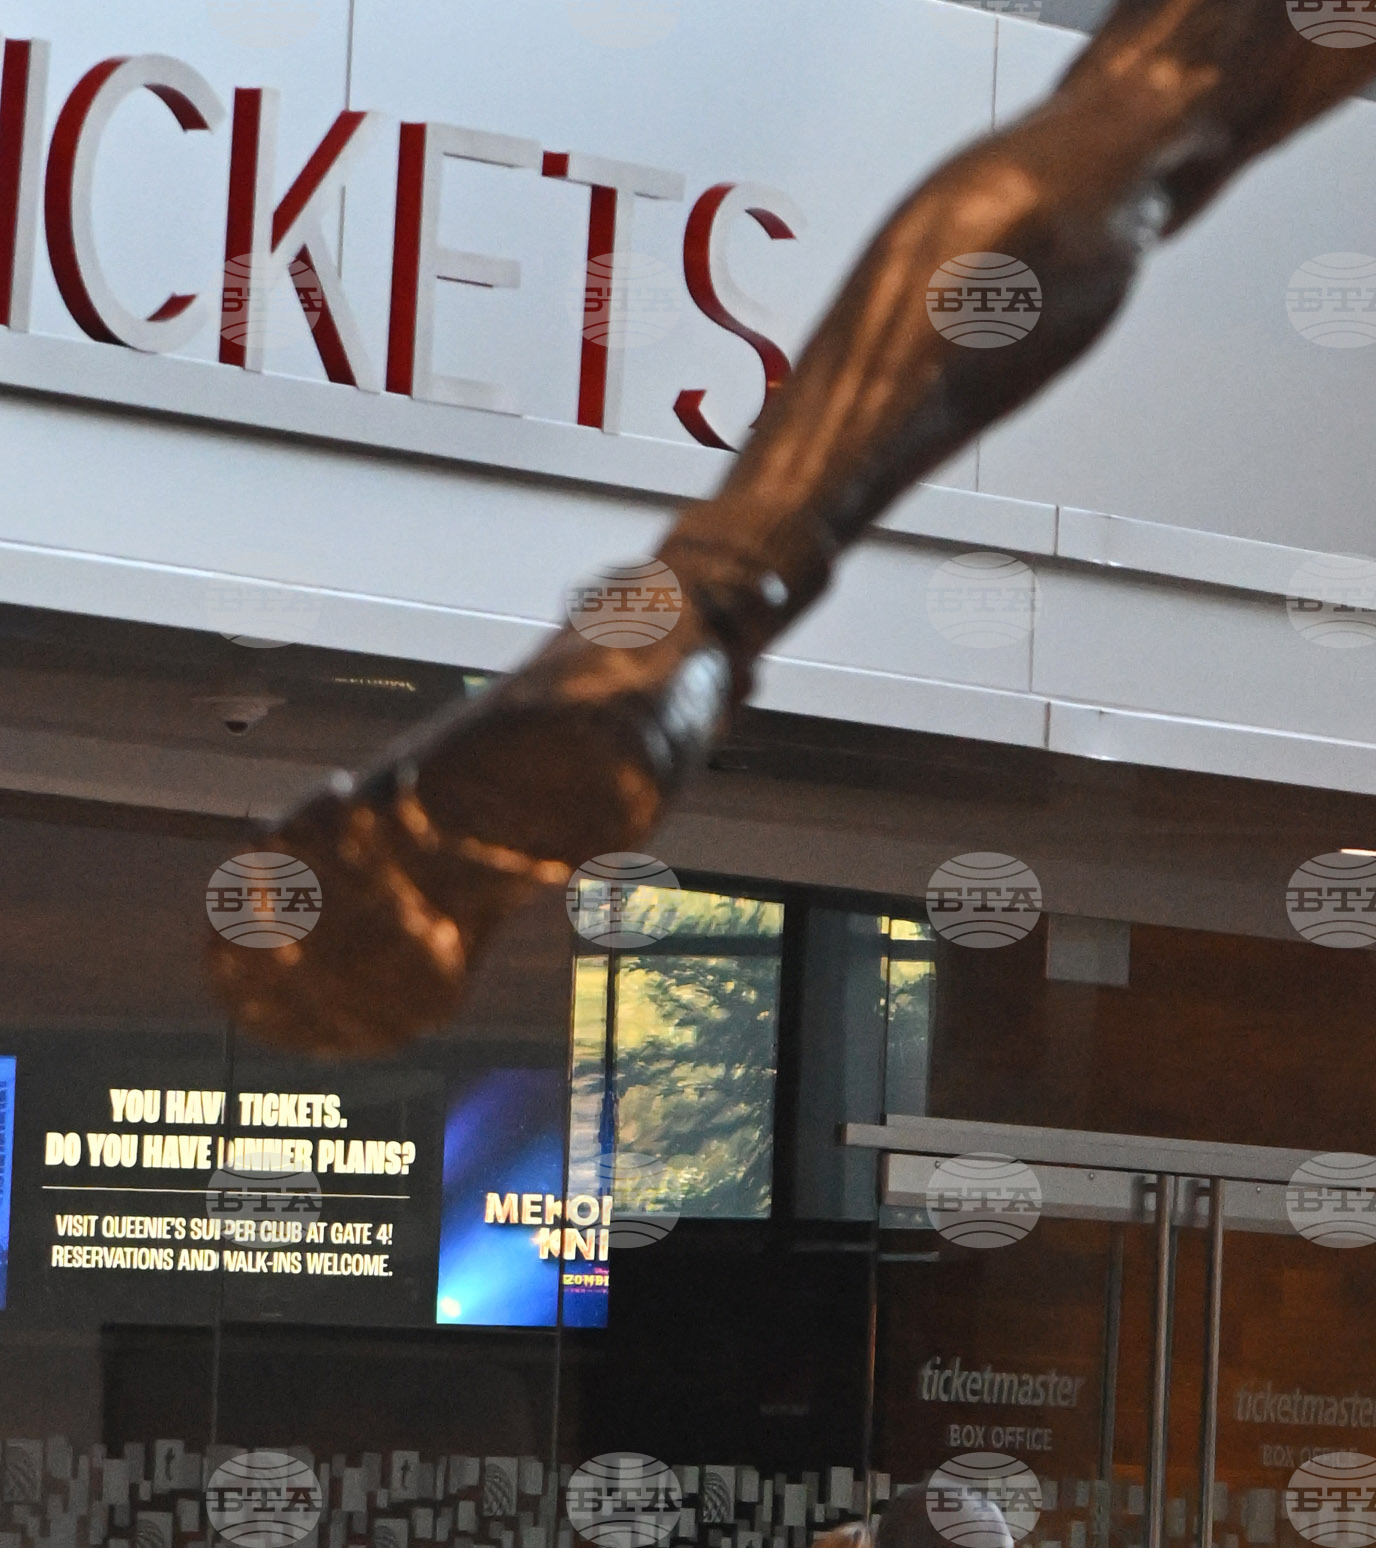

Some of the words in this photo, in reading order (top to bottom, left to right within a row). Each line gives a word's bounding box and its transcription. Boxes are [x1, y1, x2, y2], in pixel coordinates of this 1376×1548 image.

[110, 1089, 161, 1123] YOU
[165, 1090, 228, 1125] HAV
[239, 1092, 348, 1128] TICKETS.
[45, 1132, 82, 1166] DO
[86, 1133, 138, 1167] YOU
[142, 1134, 212, 1169] HAVE
[217, 1137, 314, 1172] DINNER
[317, 1139, 416, 1175] PLANS?
[56, 1215, 98, 1237] VISIT
[102, 1216, 186, 1240] QUEENIE'S
[260, 1220, 302, 1243] CLUB
[306, 1222, 327, 1243] AT
[331, 1222, 371, 1244] GATE
[376, 1223, 393, 1245] 4!
[52, 1246, 173, 1270] RESERVATIONS
[178, 1249, 219, 1271] AND
[306, 1252, 393, 1276] WELCOME.
[919, 1356, 1086, 1407] ticketmaster
[949, 1424, 985, 1448] BOX
[991, 1426, 1053, 1450] OFFICE
